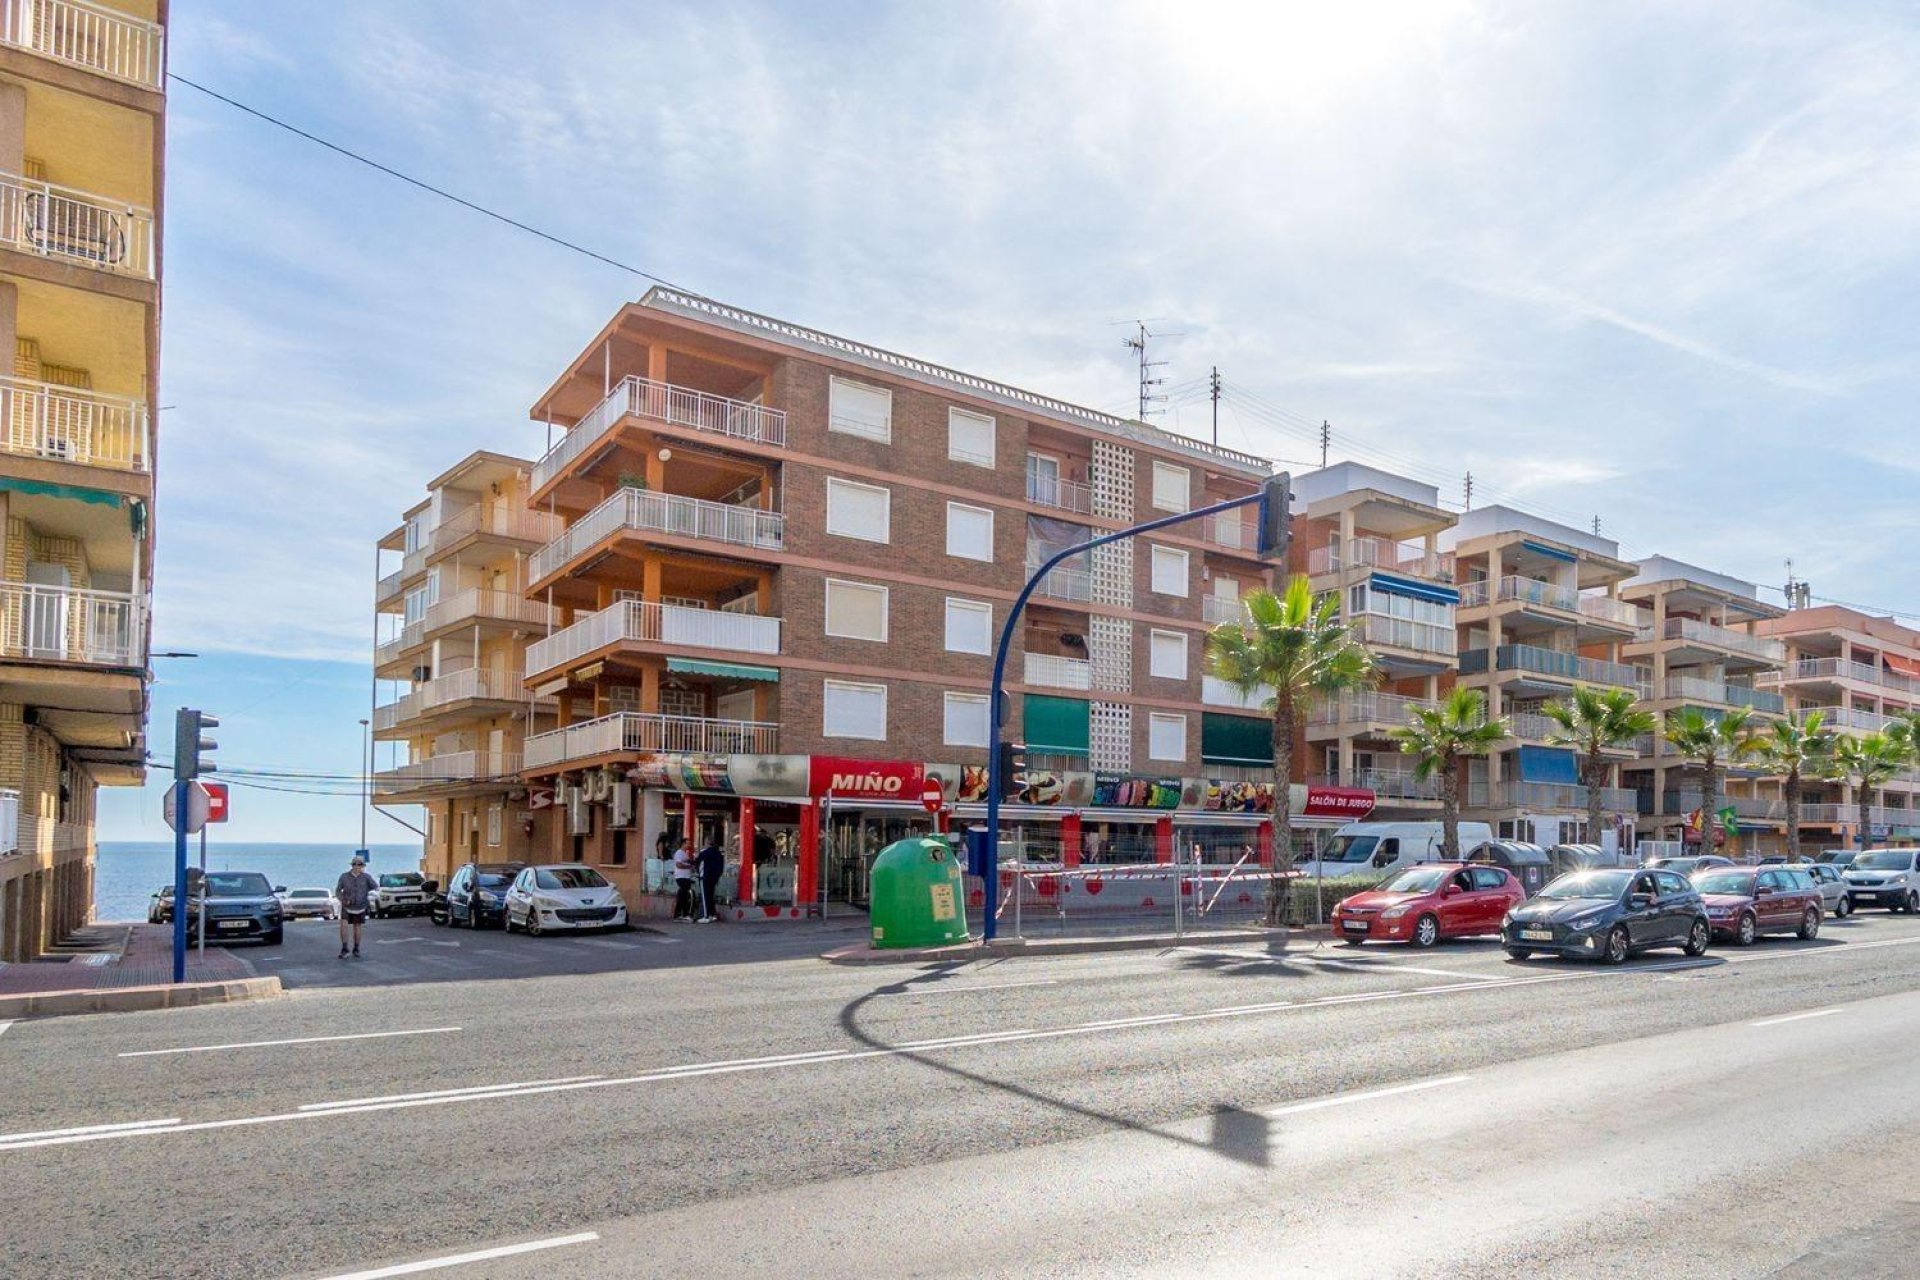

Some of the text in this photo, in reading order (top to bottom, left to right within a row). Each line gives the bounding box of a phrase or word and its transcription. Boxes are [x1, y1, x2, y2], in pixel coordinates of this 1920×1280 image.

[832, 771, 902, 791] MIÑO
[1310, 795, 1372, 808] SALÓN DE JUEGO
